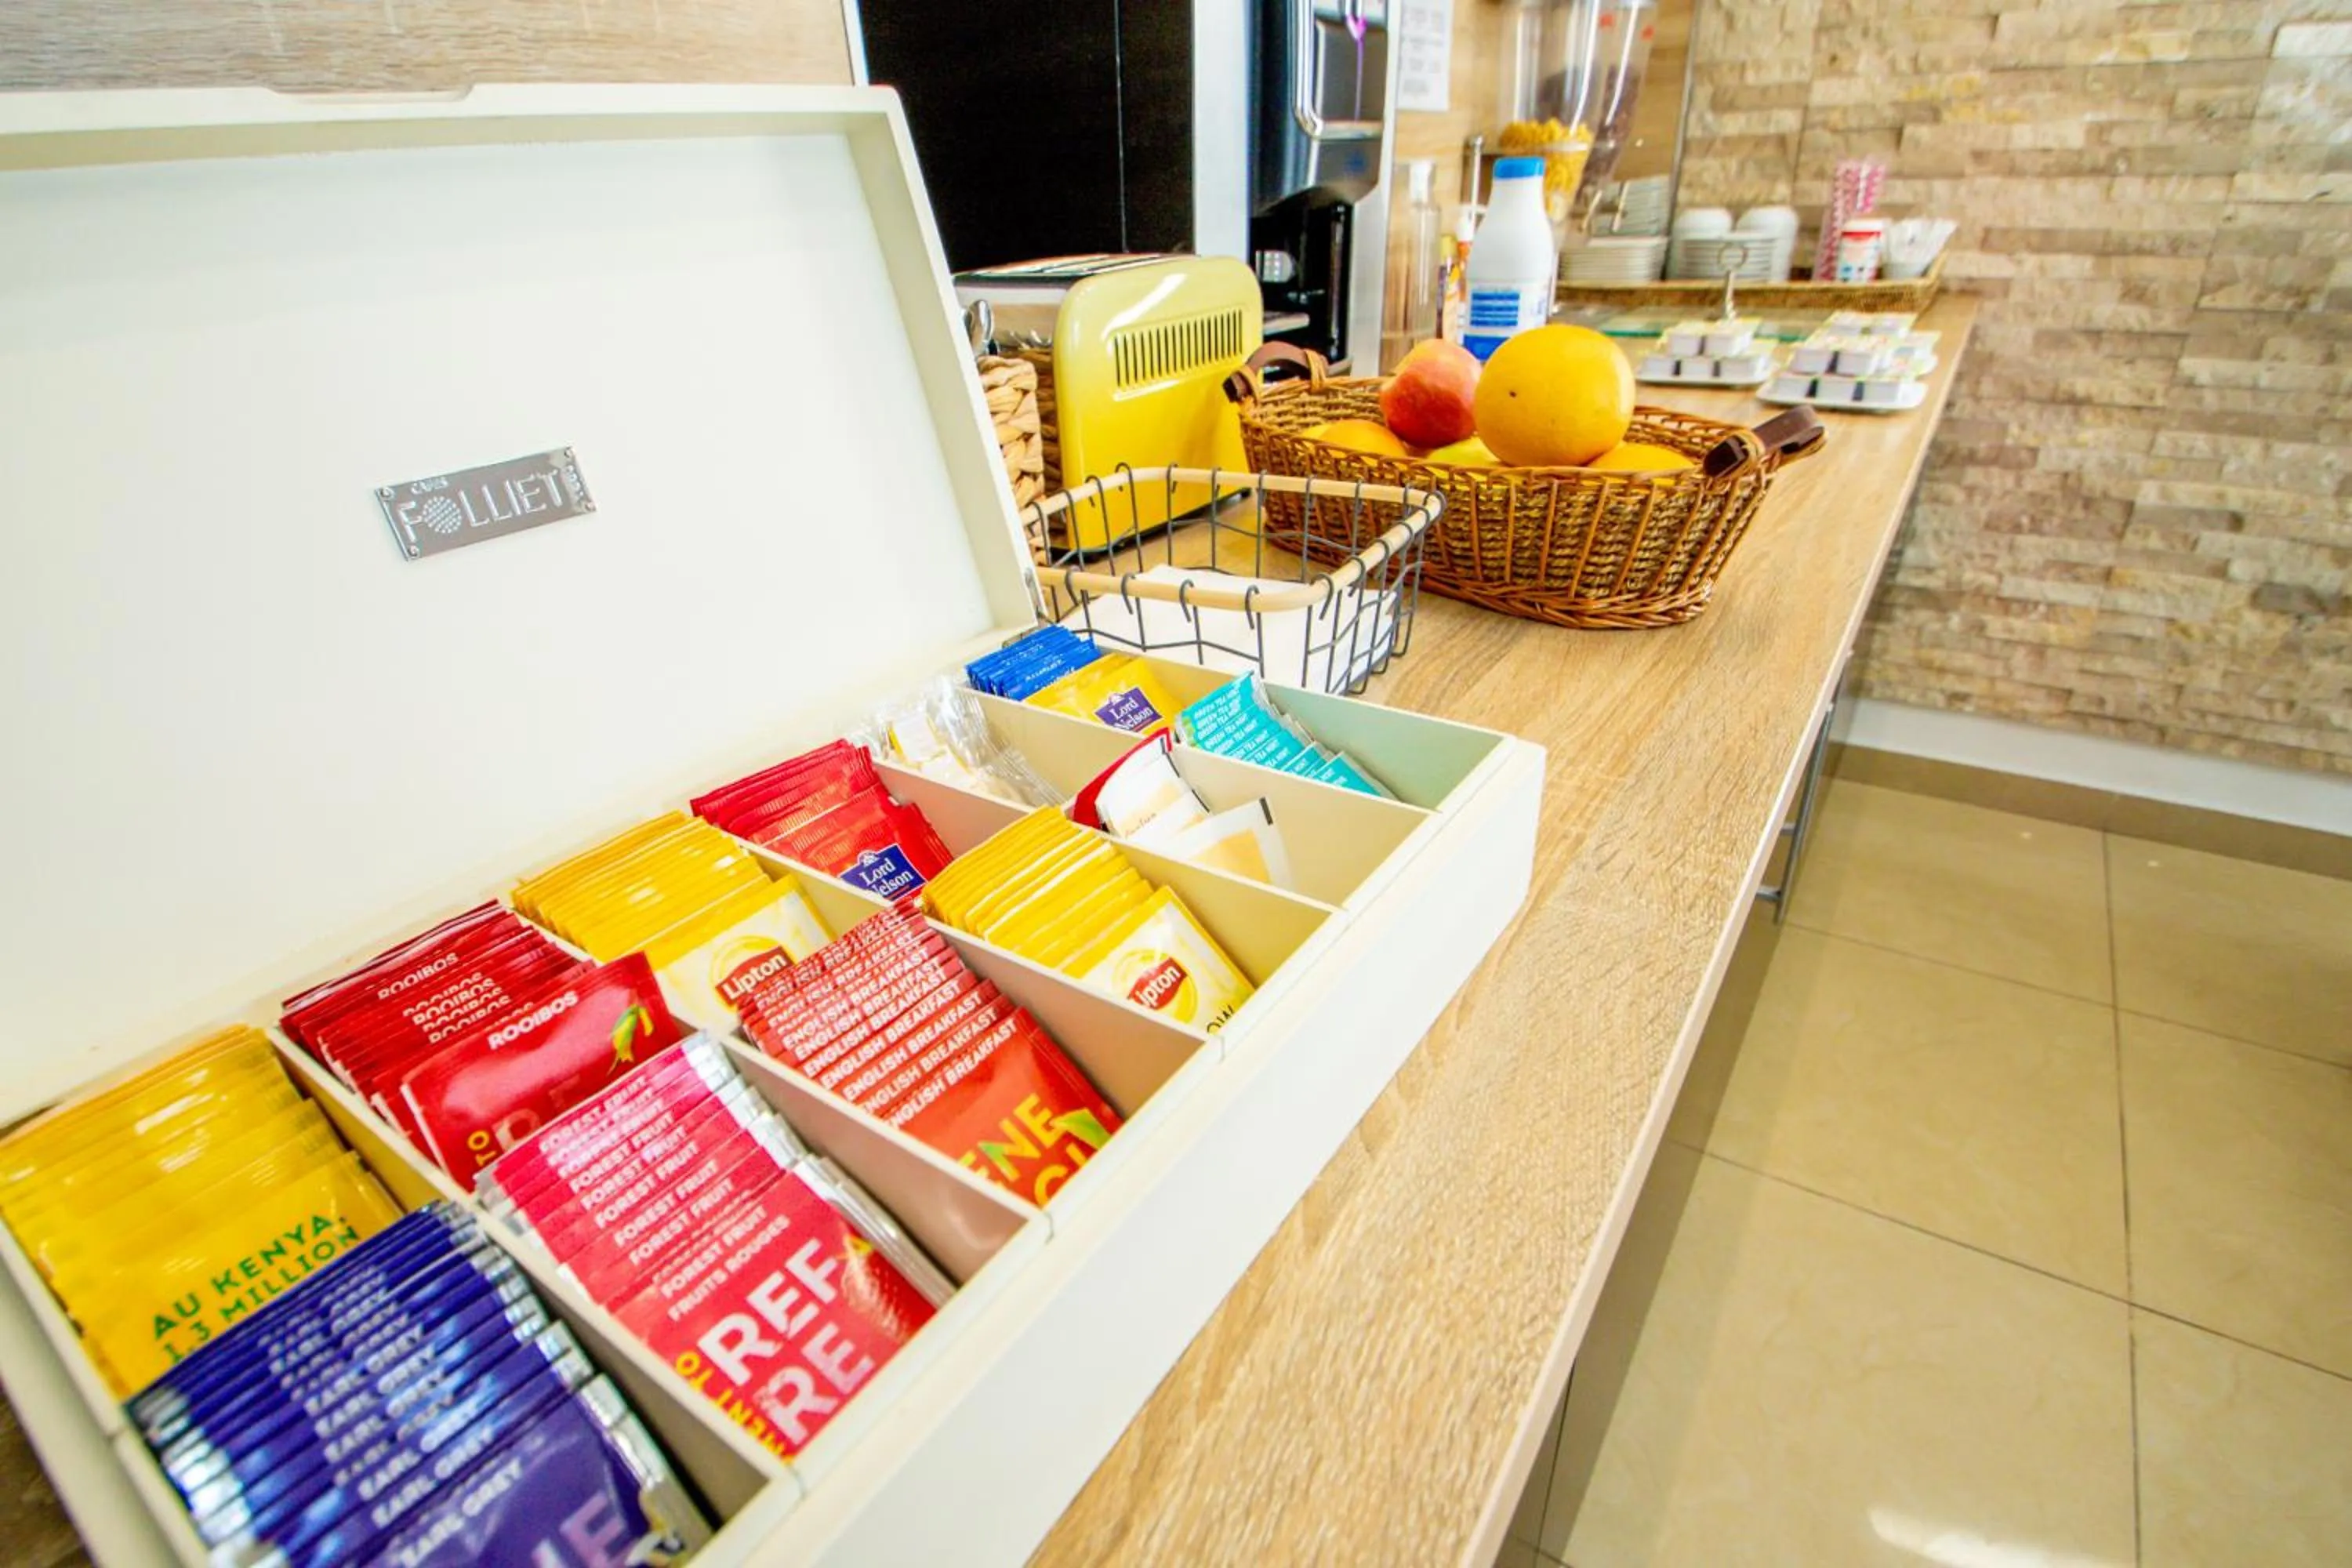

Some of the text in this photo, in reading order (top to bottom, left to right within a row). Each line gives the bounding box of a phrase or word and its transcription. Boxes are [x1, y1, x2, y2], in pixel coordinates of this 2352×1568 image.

[1109, 698, 1138, 719] Lord
[859, 858, 896, 886] Lord
[378, 953, 459, 1000] ROOIBOS
[722, 953, 786, 1000] Lipton
[782, 1000, 849, 1049] ENGLISH
[850, 948, 930, 1005] BREAKFAST
[796, 1010, 861, 1060] ENGLISH
[863, 956, 940, 1014] BREAKFAST
[1135, 967, 1181, 1007] ipton
[488, 990, 579, 1050] ROOIBOS
[805, 1023, 869, 1076] ENGLISH
[870, 968, 946, 1029] BREAKFAST
[822, 1037, 884, 1089] ENGLISH
[886, 980, 961, 1042] BREAKFAST
[844, 990, 982, 1101] ENGLISH BREAKFAST
[923, 1008, 997, 1071] BREAKFAST
[946, 1018, 1018, 1084] BREAKFAST
[541, 1105, 600, 1153] FOREST
[571, 1142, 630, 1193] FOREST
[633, 1111, 673, 1148] FRUIT
[583, 1125, 685, 1210] FOREST FRUIT
[597, 1175, 655, 1228] FOREST
[658, 1142, 698, 1181] FRUIT
[615, 1193, 674, 1246] FOREST
[677, 1160, 718, 1199] FRUIT
[630, 1213, 689, 1265] FOREST
[692, 1178, 733, 1218] FRUIT
[219, 1225, 360, 1323] MILLION
[662, 1241, 723, 1298] FOREST
[724, 1205, 766, 1247] FRUIT
[670, 1266, 725, 1320] FRUITS
[727, 1213, 789, 1272] ROUGES
[154, 1293, 201, 1341] AU
[697, 1237, 838, 1387] REF
[305, 1326, 426, 1414] EARL GREY
[316, 1345, 436, 1437] EARL GREY
[753, 1322, 876, 1446] RE
[325, 1414, 383, 1461] EARL
[359, 1449, 419, 1499] EARL
[374, 1475, 433, 1526] EARL
[401, 1510, 463, 1567] EARL
[461, 1459, 523, 1517] GREY
